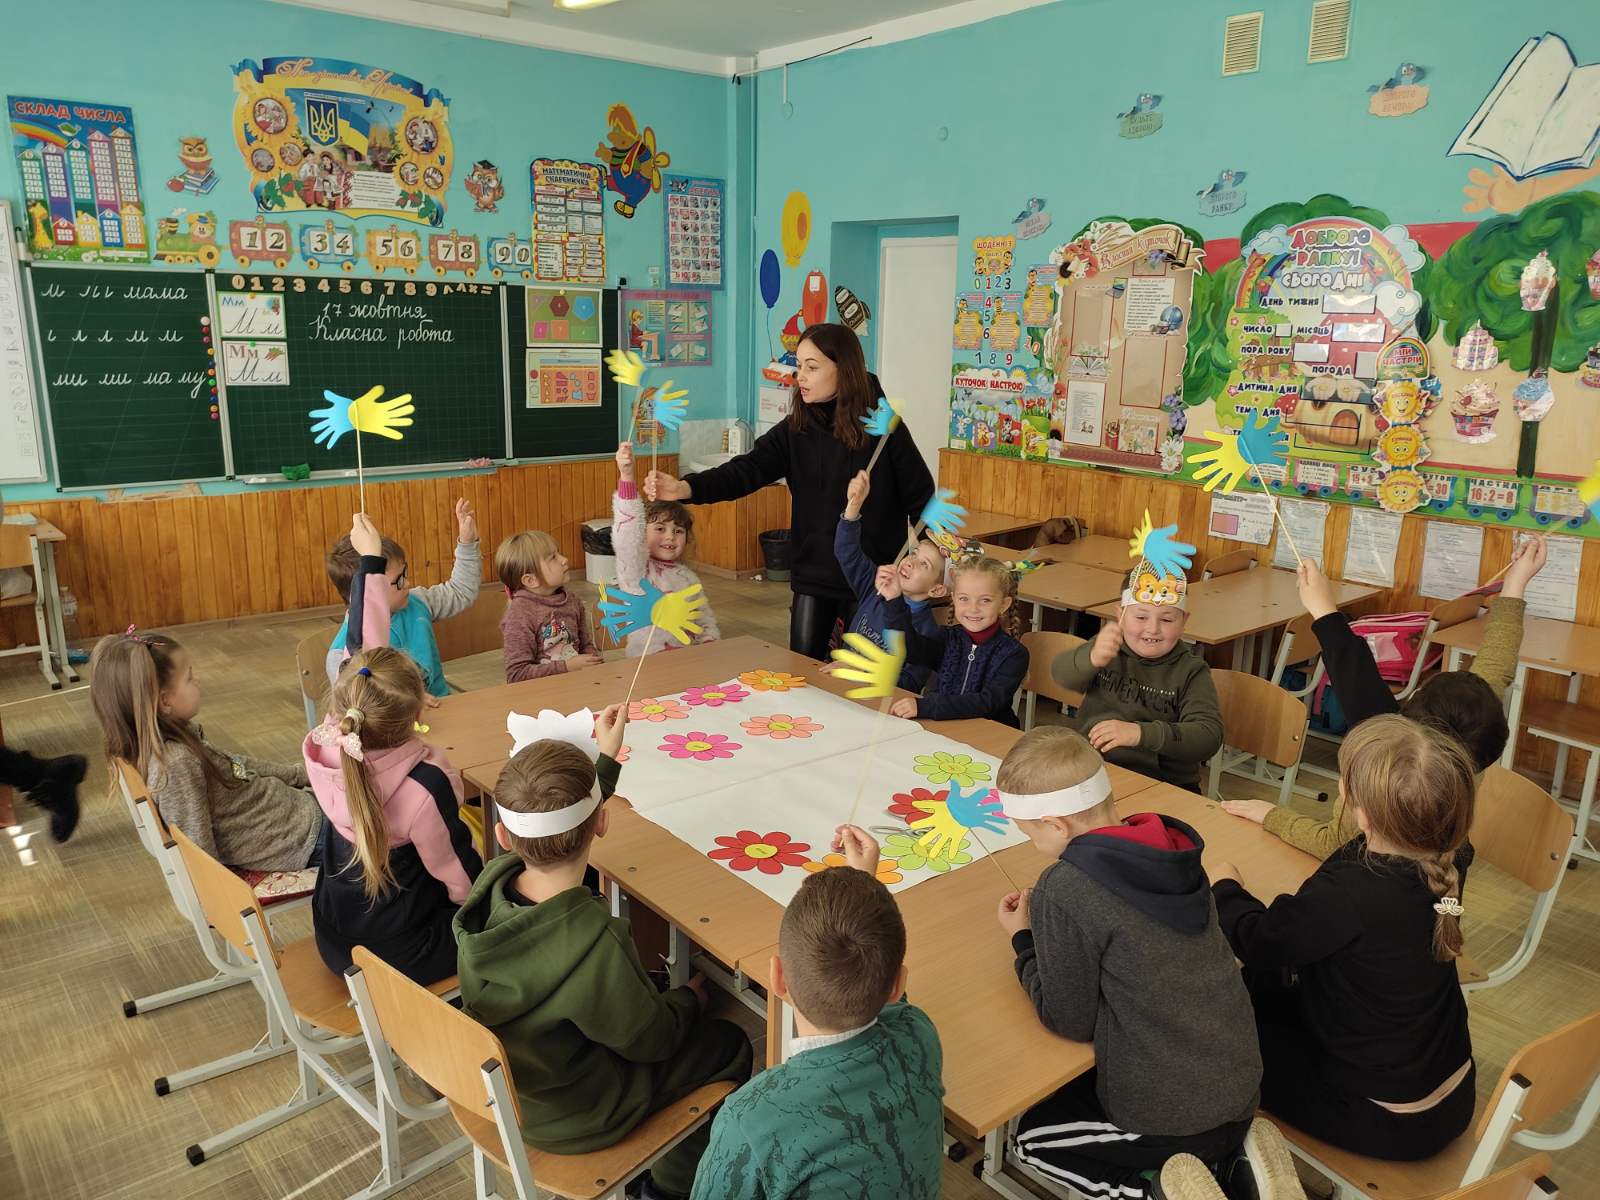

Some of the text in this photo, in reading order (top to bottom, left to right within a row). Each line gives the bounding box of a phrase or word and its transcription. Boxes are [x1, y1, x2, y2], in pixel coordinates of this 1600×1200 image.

[15, 101, 126, 124] СКЛАД ЧИСЛА
[245, 230, 258, 248] 1
[268, 231, 284, 249] 2
[313, 233, 328, 252] 3
[336, 234, 351, 252] 4
[380, 238, 393, 256] 5
[400, 238, 414, 257] 6
[442, 243, 455, 259] 7
[461, 243, 473, 259] 8
[1291, 229, 1371, 249] ДОБРОГО
[232, 275, 245, 290] 0
[251, 276, 264, 291] 1
[272, 277, 285, 291] 2
[293, 278, 306, 293] 3
[317, 279, 330, 293] 4
[339, 279, 352, 293] 5
[360, 281, 373, 295] 6
[384, 281, 396, 296] 7
[404, 282, 417, 296] 8
[425, 282, 438, 297] 9
[1004, 278, 1011, 290] 3
[1282, 272, 1365, 291] СЬОГОДНІ
[123, 285, 189, 300] мама
[322, 294, 428, 319] 17 жовтня
[1260, 297, 1319, 308] ДЕНЬ ТИЖНЯ
[309, 315, 455, 350] Класна робота
[983, 328, 990, 339] 6
[1243, 325, 1330, 335] ЧИСЛО МІСЯЦЬ
[1241, 346, 1291, 355] ПОРА РОКУ
[989, 353, 997, 364] 8
[1005, 353, 1013, 365] 9
[1312, 366, 1351, 375] ПОГОДА
[955, 377, 1025, 391] КУТОЧОК НАСТРОЮ
[1237, 382, 1298, 394] ДИТИНА ДНЯ
[1262, 408, 1280, 417] ДНЯ
[1471, 479, 1518, 489] ЧАСТКА
